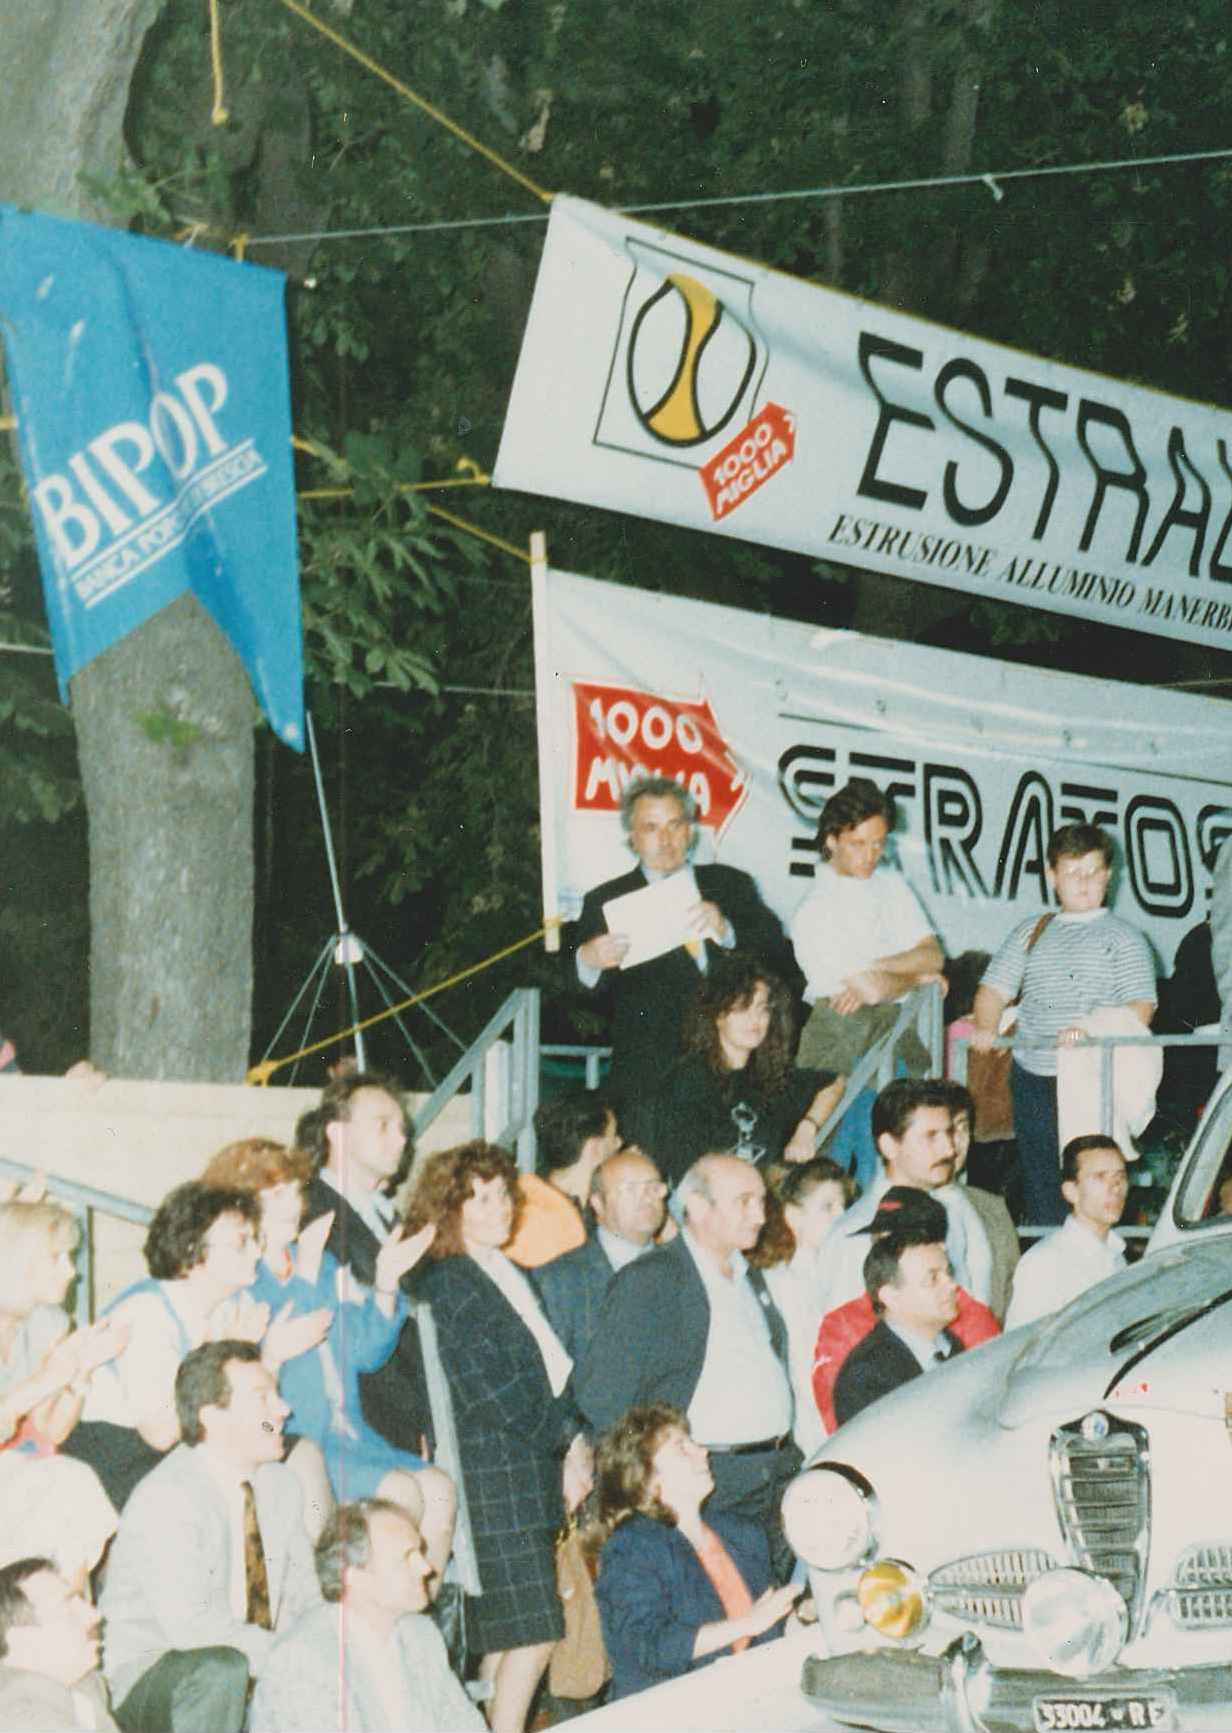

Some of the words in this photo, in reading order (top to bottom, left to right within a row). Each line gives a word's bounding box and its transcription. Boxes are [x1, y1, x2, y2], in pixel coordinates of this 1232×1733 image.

[34, 363, 229, 570] BIPOP
[713, 422, 773, 488] 1000
[716, 439, 787, 515] MIGLIA
[828, 513, 998, 578] ESTRUSIONE
[1000, 556, 1136, 610] ALLUMINIO
[588, 697, 704, 755] 1000
